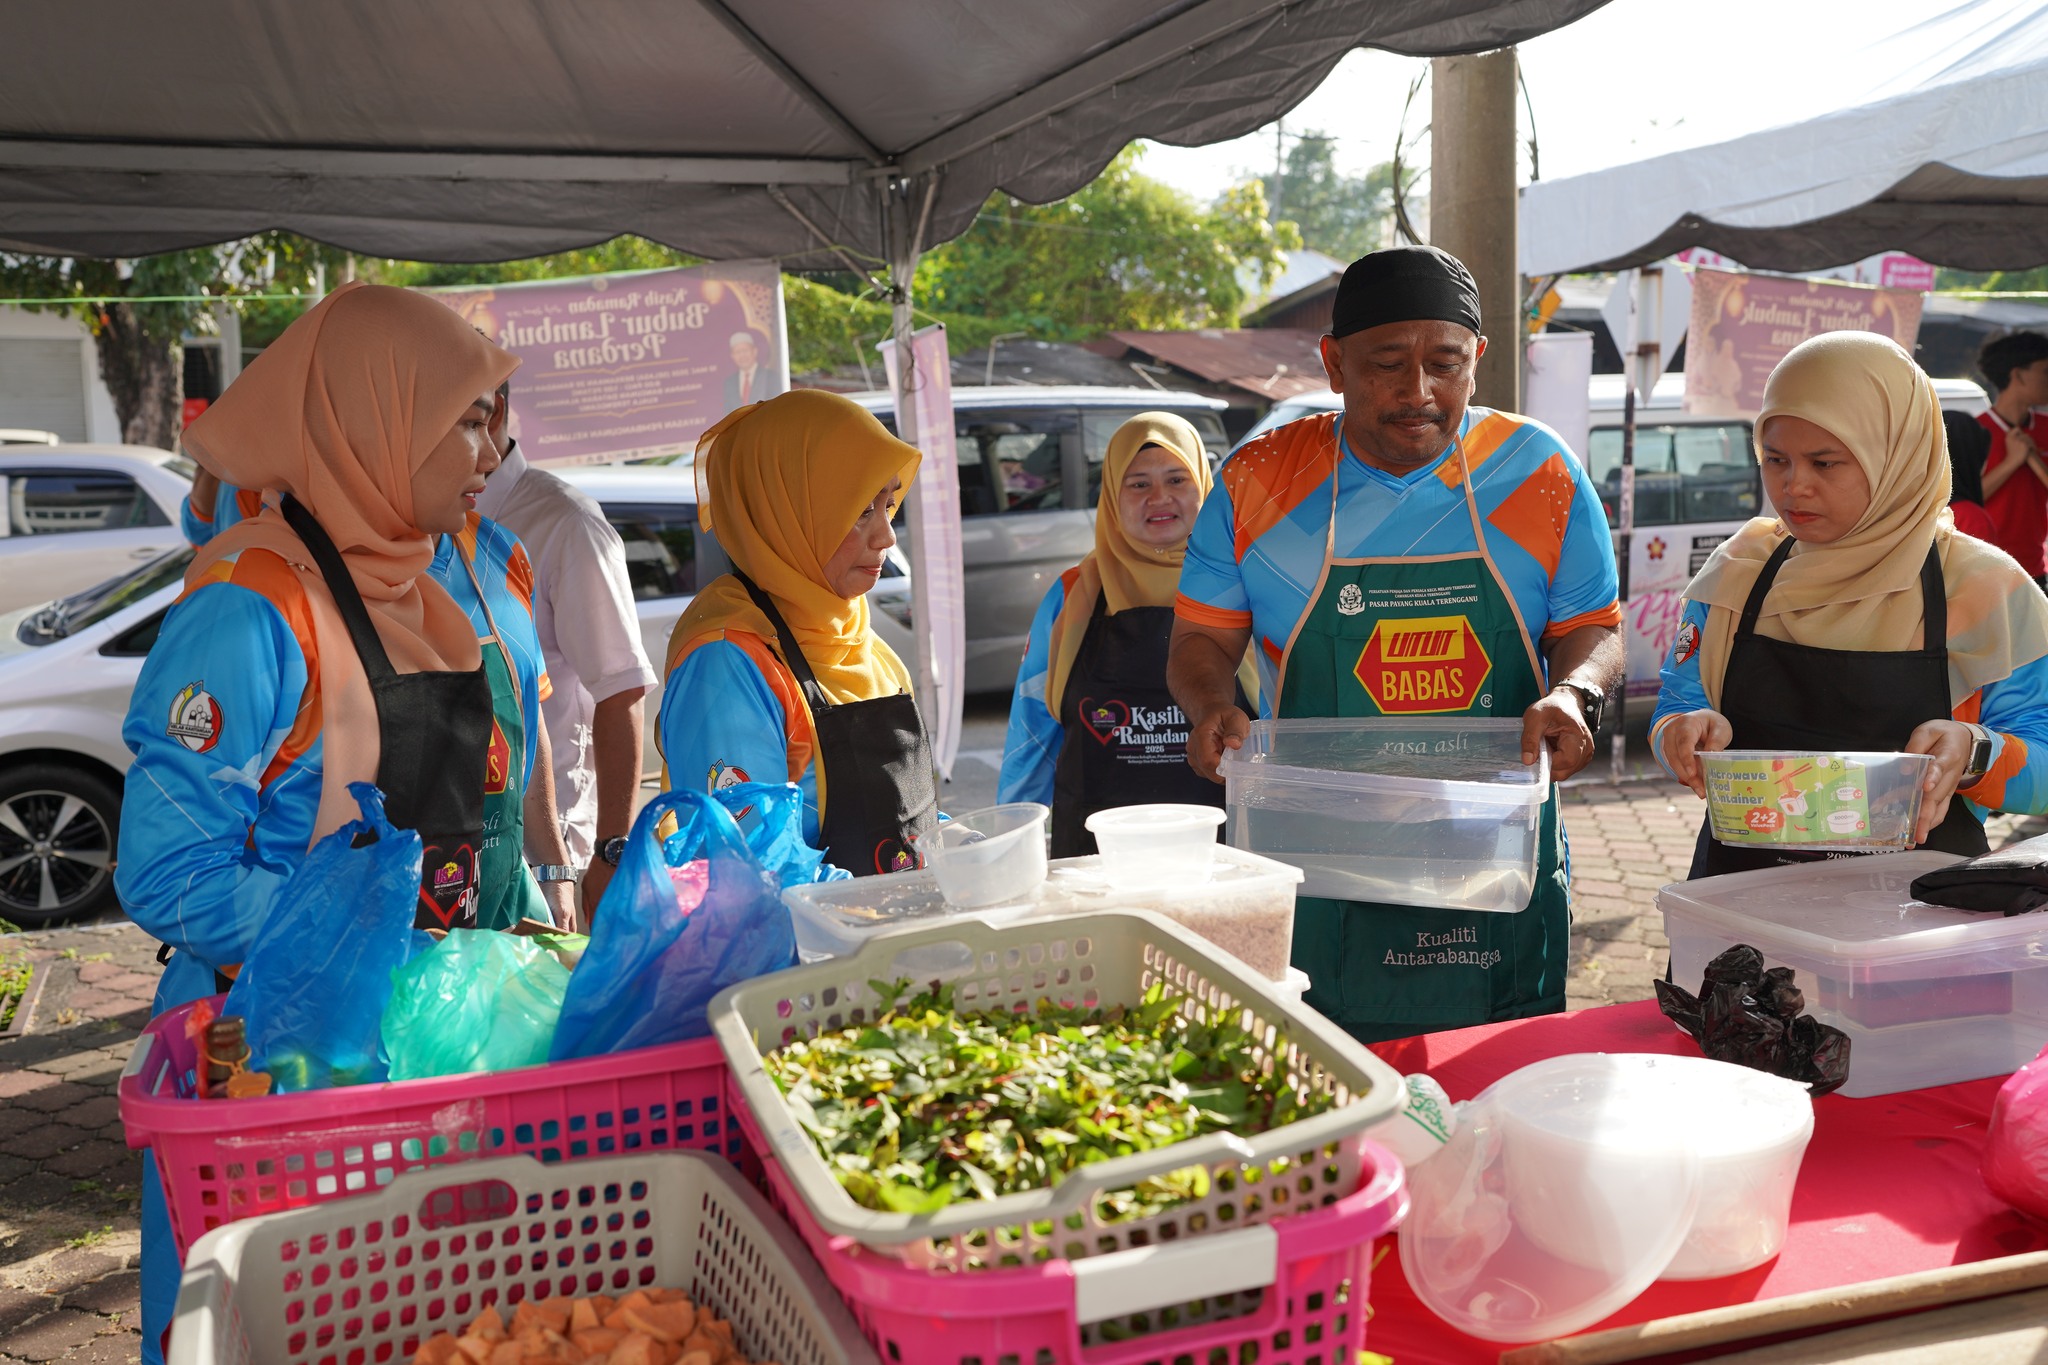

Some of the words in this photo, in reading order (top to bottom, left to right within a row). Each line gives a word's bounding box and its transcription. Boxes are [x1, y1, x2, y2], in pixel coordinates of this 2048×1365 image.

[1436, 596, 1478, 604] TERENGGANU
[1381, 665, 1464, 702] BABA'S
[1131, 706, 1185, 731] Kasih
[1112, 726, 1189, 745] Ramadan
[1379, 741, 1427, 755] rasa
[1434, 731, 1469, 753] asli
[1145, 745, 1164, 753] 2026
[482, 811, 500, 831] sli
[1751, 812, 1778, 823] 2+2
[1416, 926, 1478, 948] Kualiti
[1382, 947, 1502, 970] Antarabangsa
